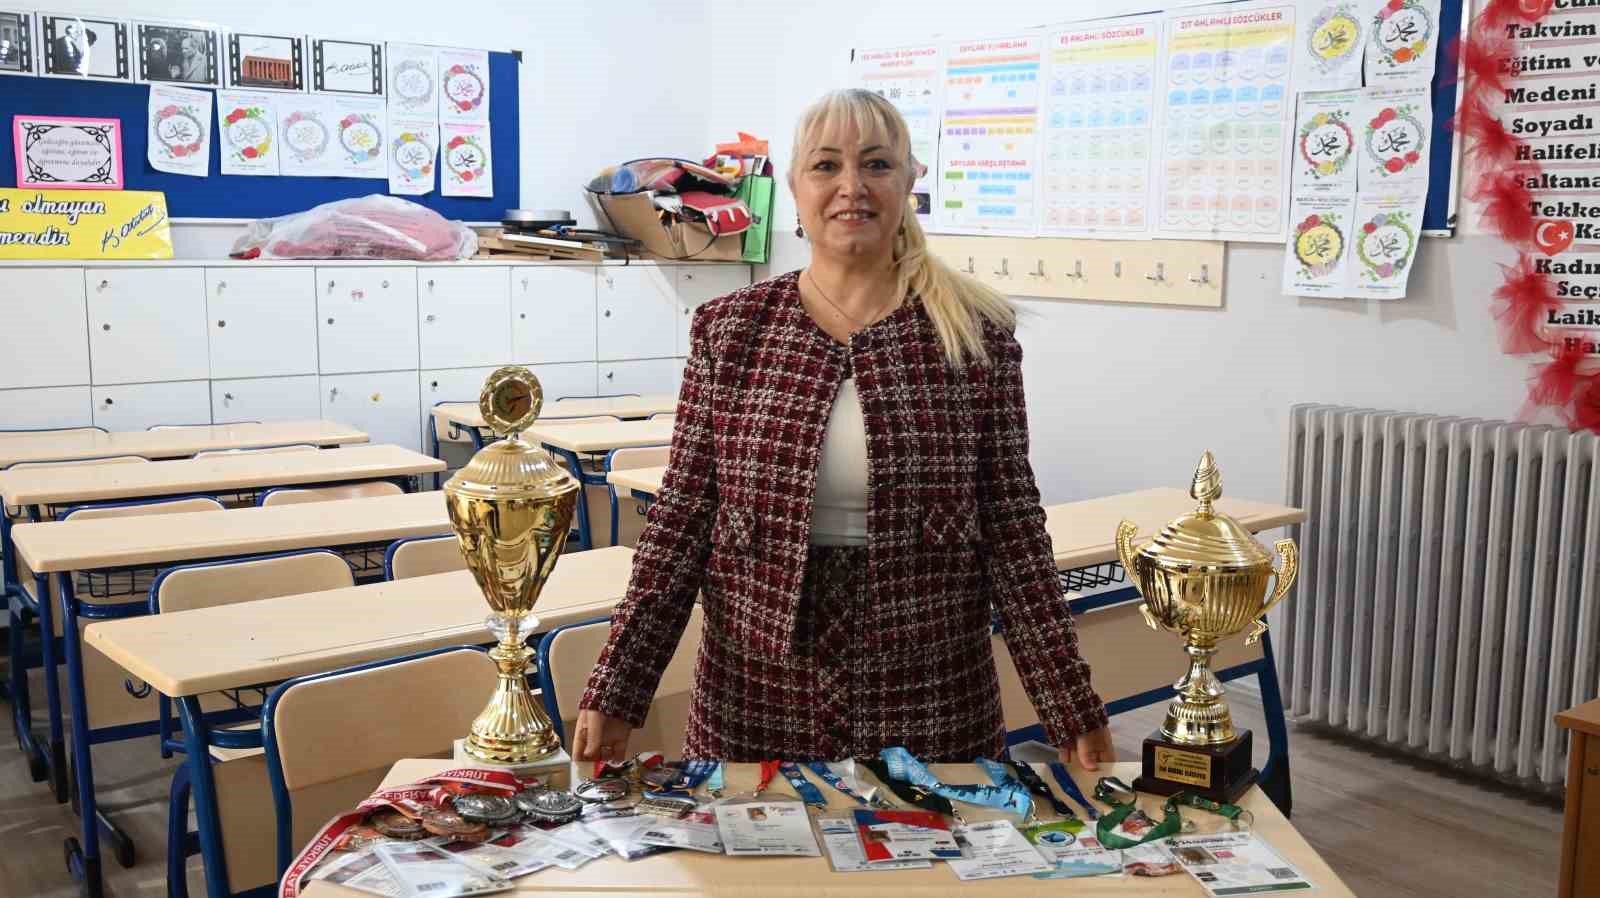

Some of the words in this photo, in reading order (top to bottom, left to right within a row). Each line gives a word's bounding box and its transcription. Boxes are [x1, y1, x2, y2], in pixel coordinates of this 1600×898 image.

[1506, 20, 1596, 39] Takvim
[1498, 55, 1571, 77] Eğitim
[1583, 55, 1600, 68] v
[1504, 84, 1596, 104] Medeni
[1512, 114, 1593, 136] Soyadı
[21, 193, 105, 225] olmayan
[1530, 202, 1600, 217] Tekke
[1557, 281, 1600, 299] Seç
